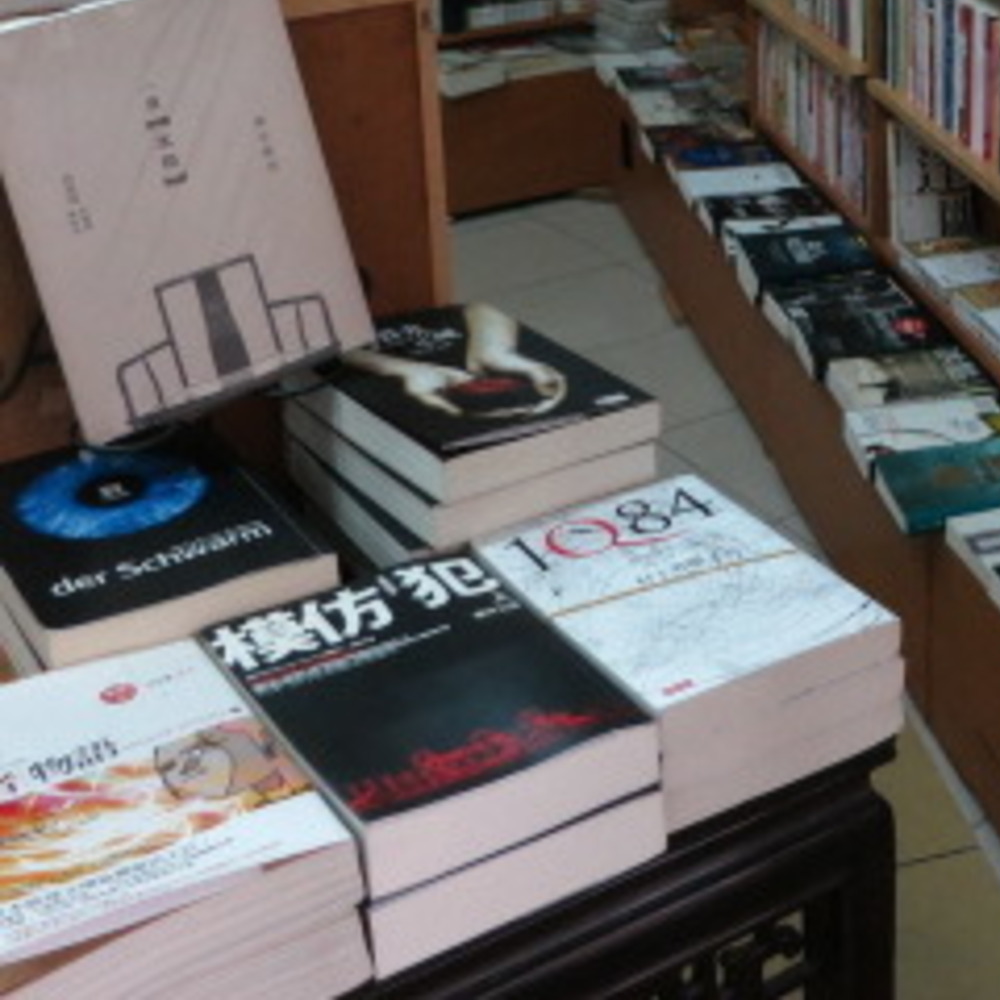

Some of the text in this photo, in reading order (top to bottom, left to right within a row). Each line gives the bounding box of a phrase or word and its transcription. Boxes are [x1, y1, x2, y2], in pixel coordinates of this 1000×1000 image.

[50, 517, 273, 598] der Schwarm
[507, 487, 716, 573] 1Q84
[211, 557, 500, 670] 模仿犯
